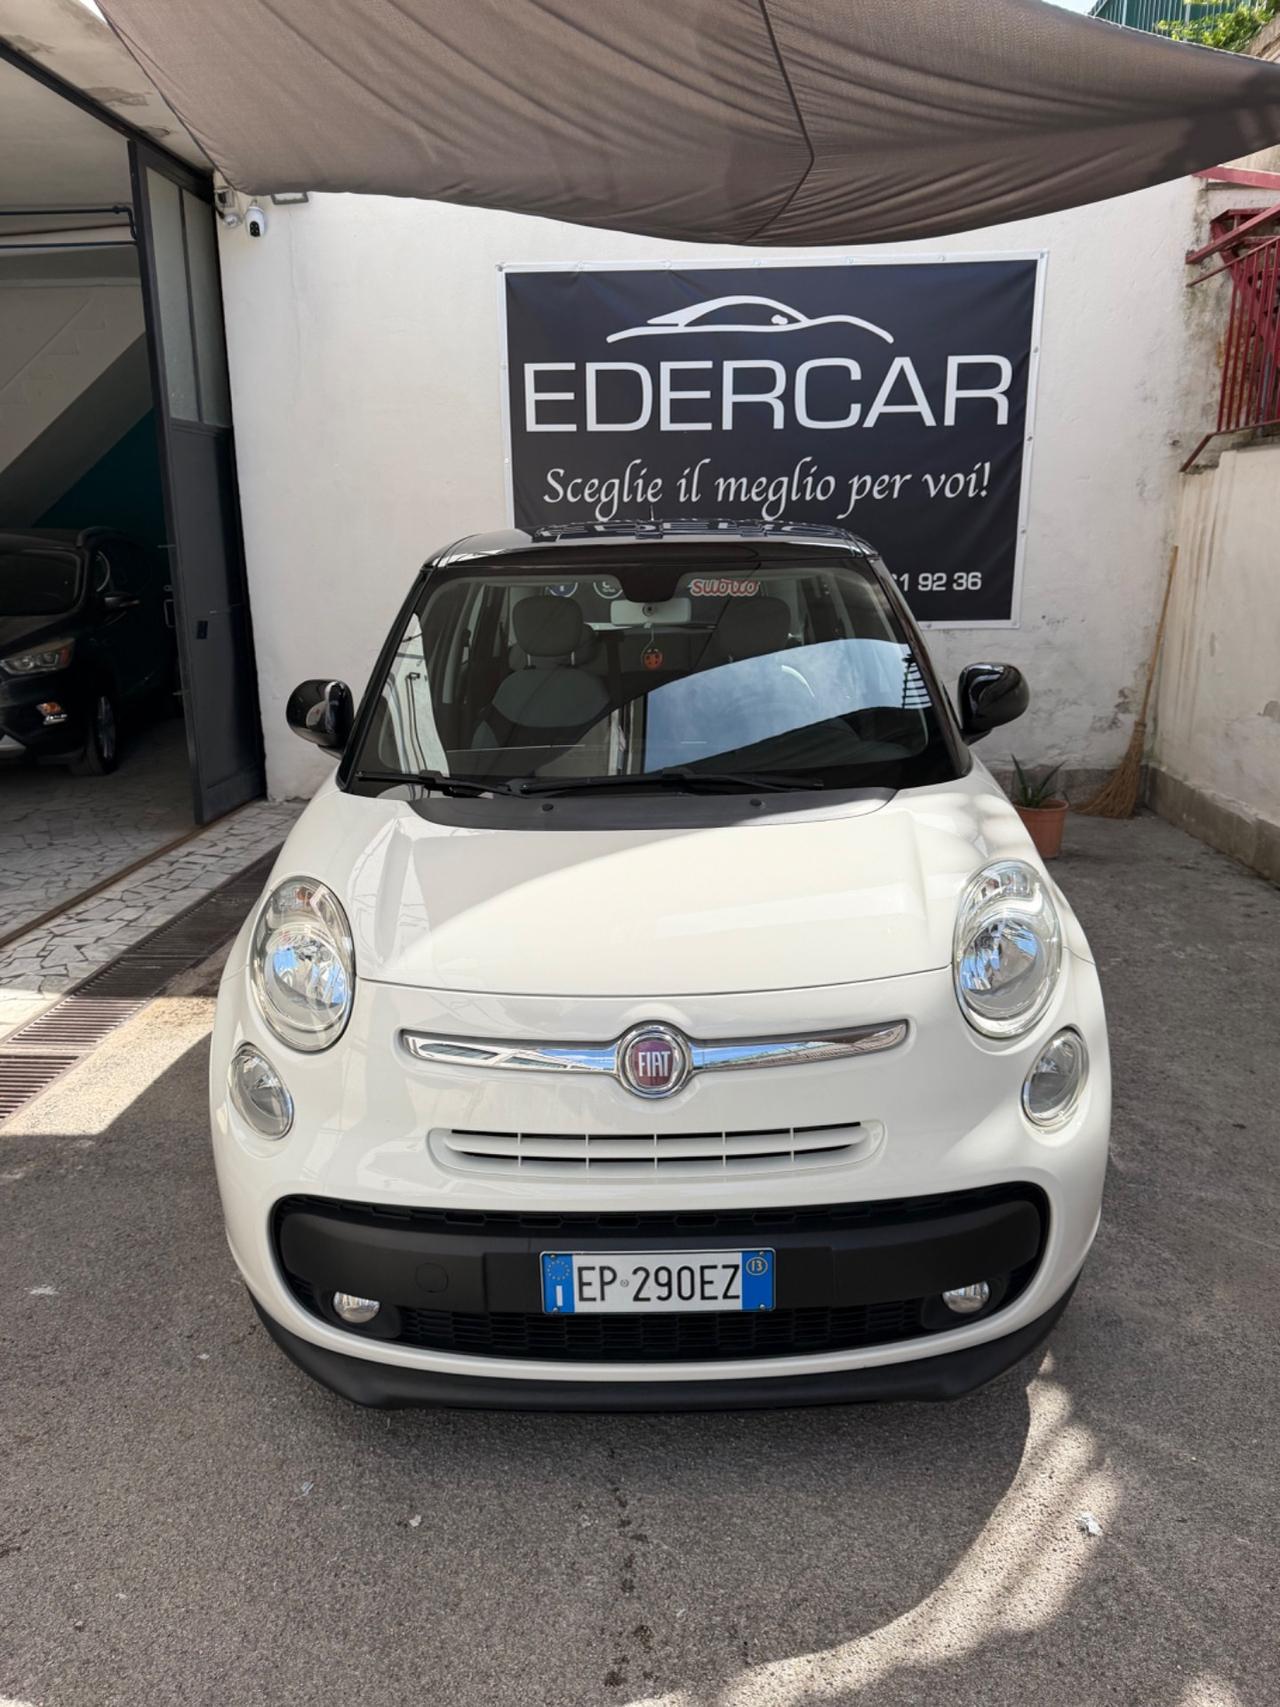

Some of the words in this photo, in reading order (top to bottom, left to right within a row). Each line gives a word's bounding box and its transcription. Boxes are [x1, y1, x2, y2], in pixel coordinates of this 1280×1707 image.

[523, 354, 1013, 433] EDERCAR
[543, 458, 664, 522] Sceglie
[677, 457, 712, 503] il
[715, 456, 836, 521] meglio
[836, 473, 913, 520] per
[921, 461, 991, 499] voi!
[892, 572, 909, 592] 1
[918, 572, 947, 592] 92
[952, 571, 982, 591] 36
[638, 1050, 671, 1078] FIAT
